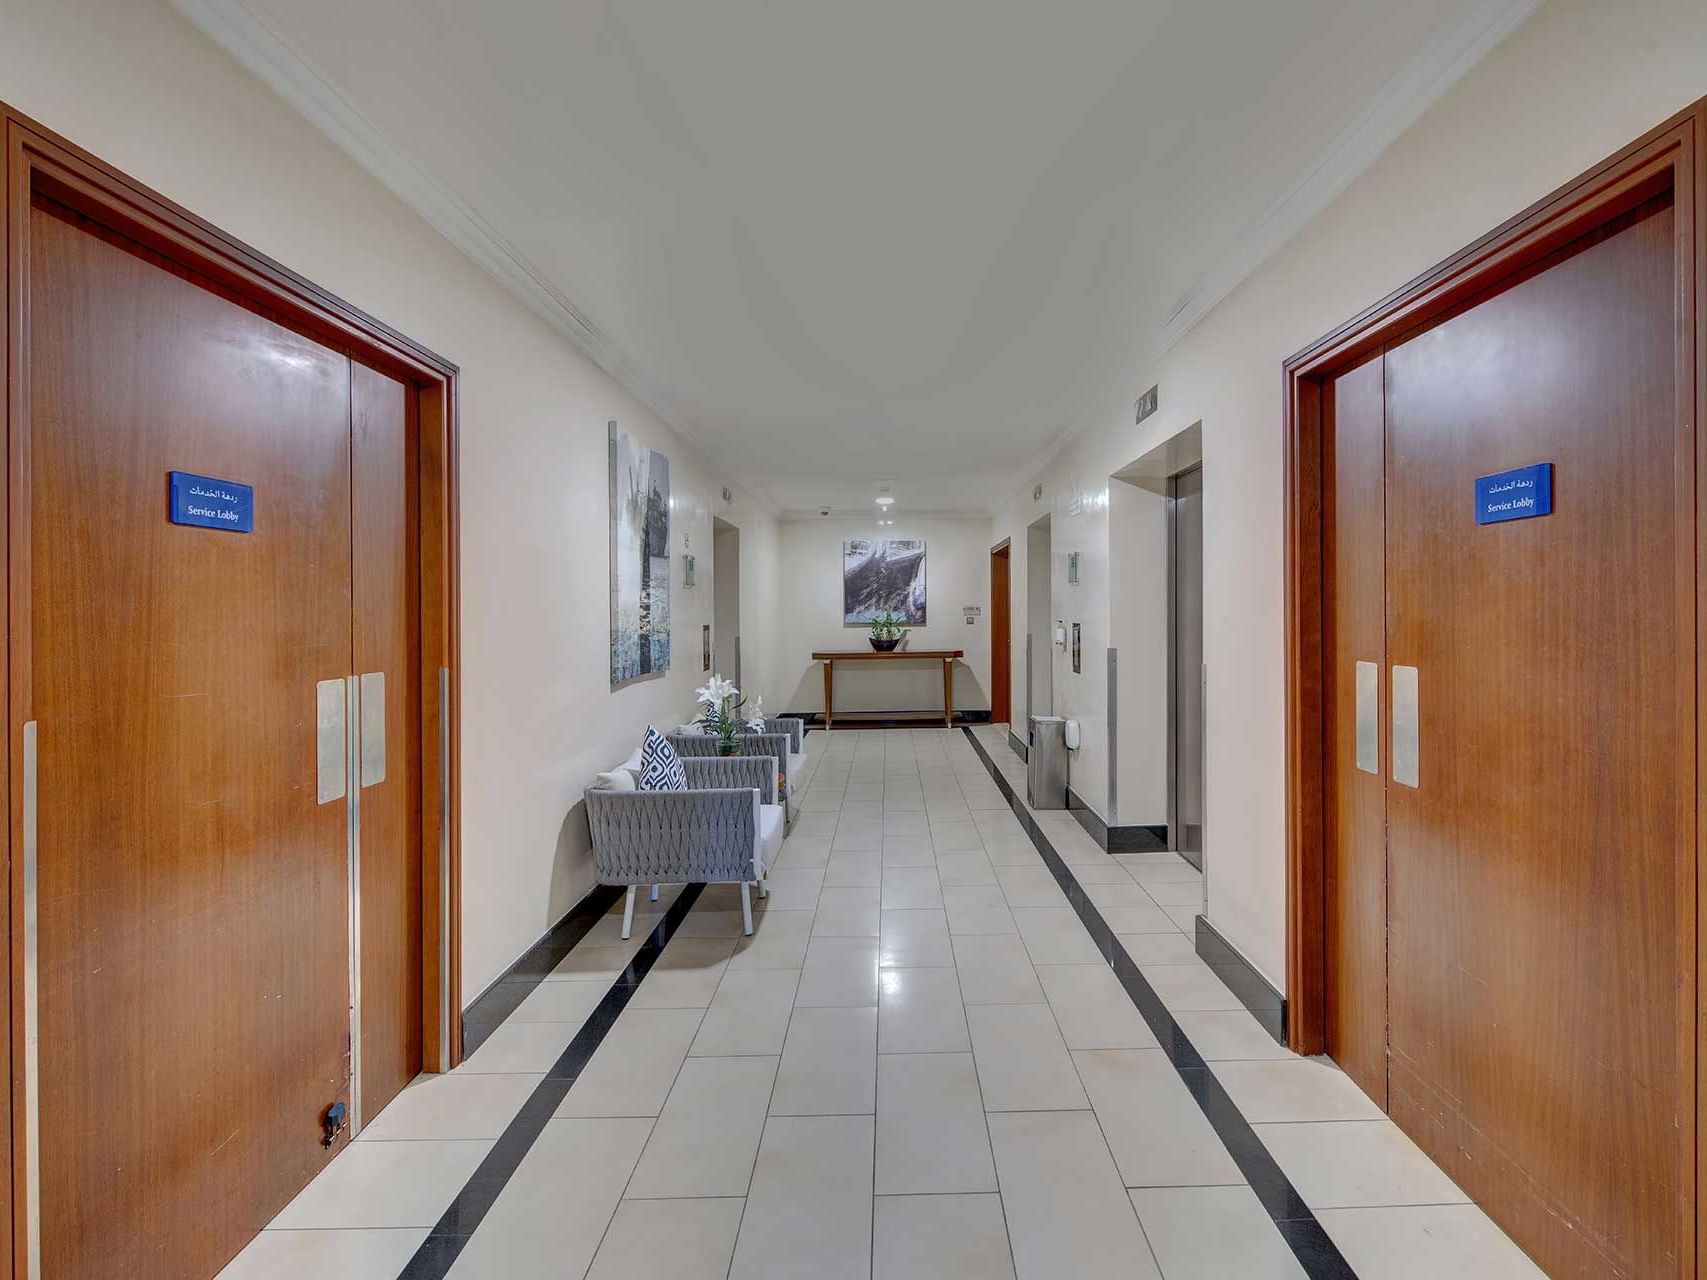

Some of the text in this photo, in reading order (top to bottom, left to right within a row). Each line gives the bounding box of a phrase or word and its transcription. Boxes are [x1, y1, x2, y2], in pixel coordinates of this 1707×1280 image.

[189, 486, 238, 503] ردهة الخدمات
[1489, 481, 1515, 494] الخدمات
[1487, 497, 1535, 513] Service Lobby
[188, 505, 239, 523] Service Lobby
